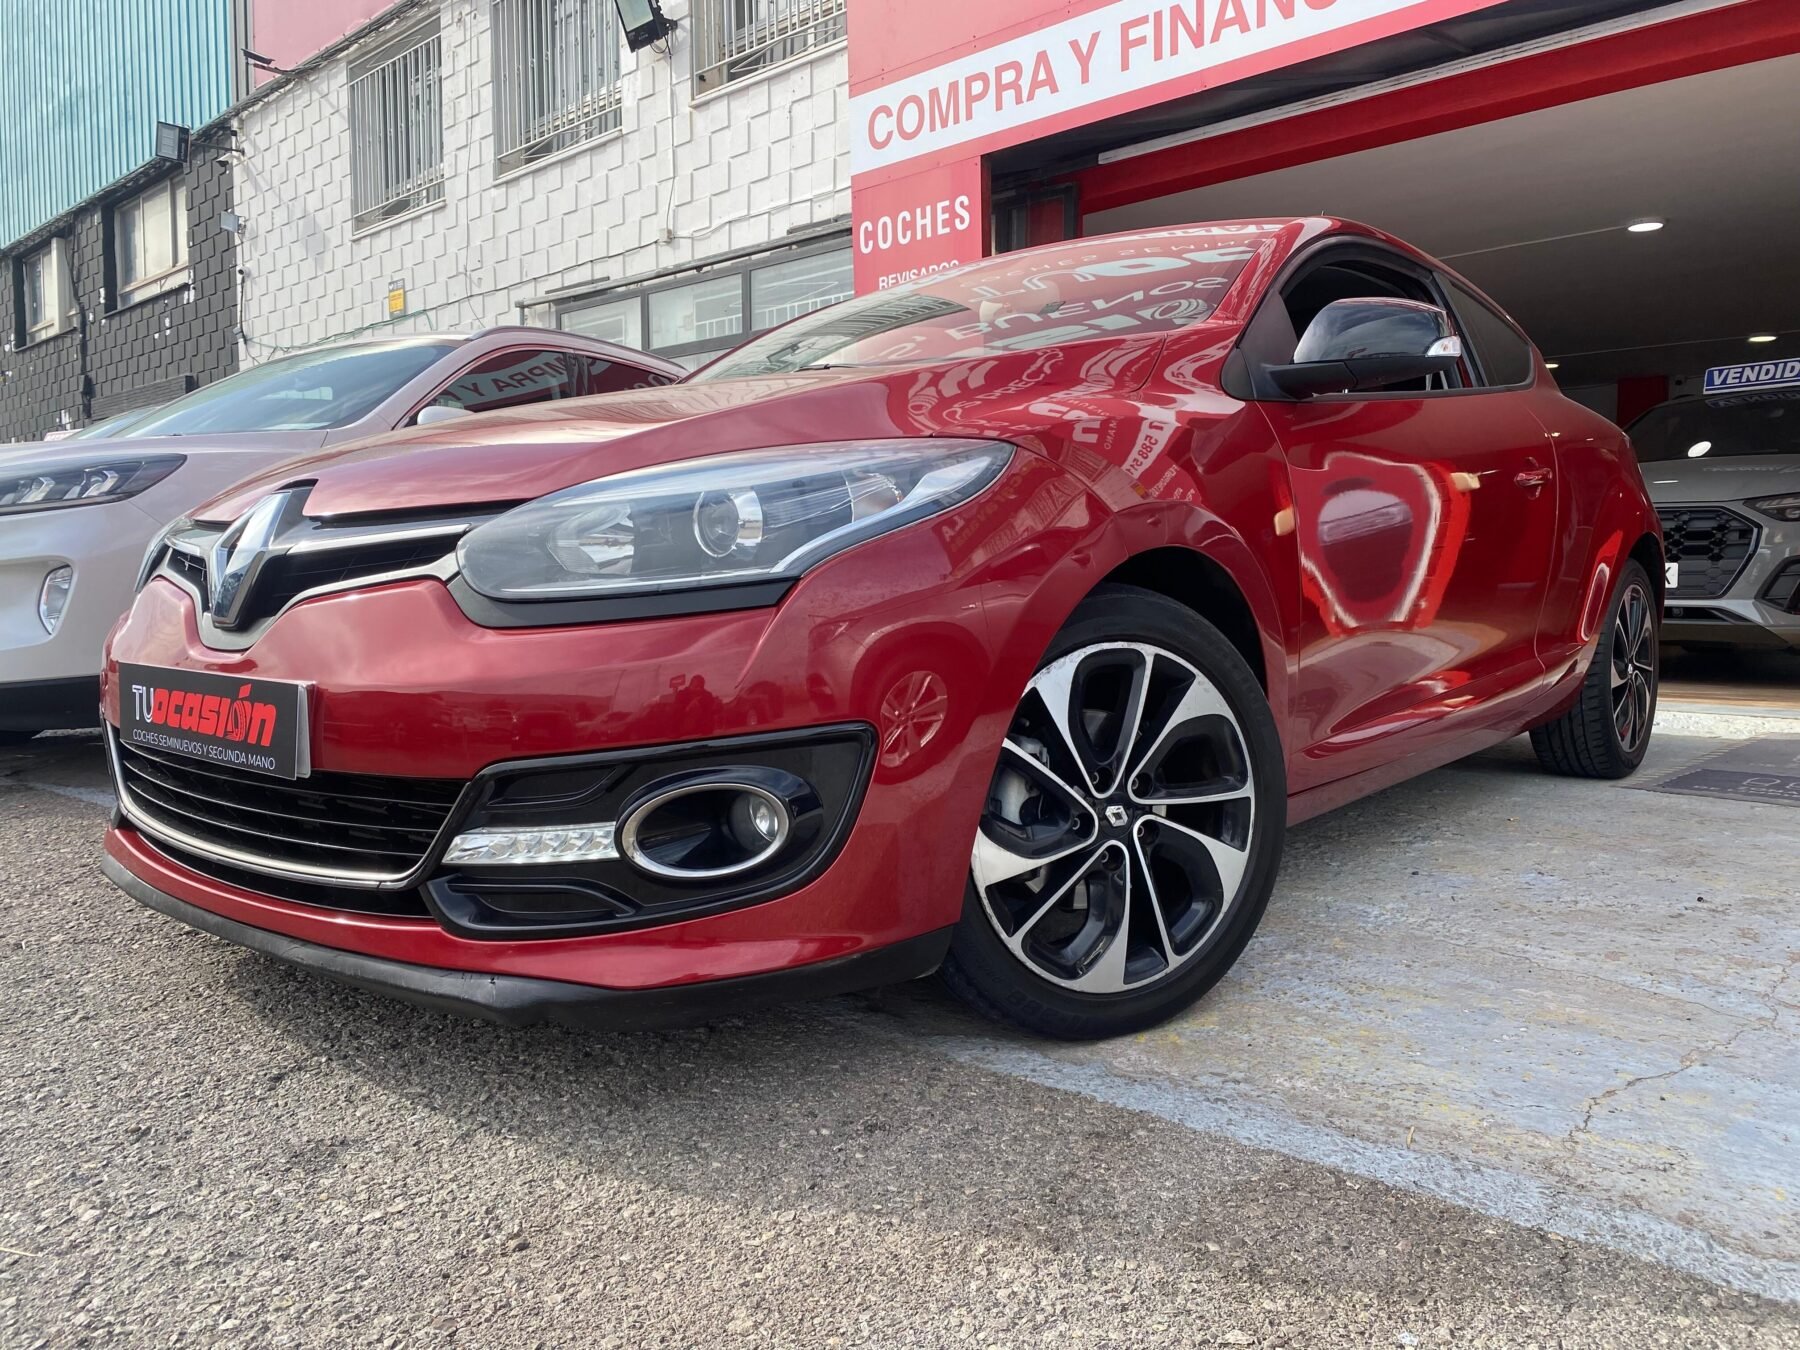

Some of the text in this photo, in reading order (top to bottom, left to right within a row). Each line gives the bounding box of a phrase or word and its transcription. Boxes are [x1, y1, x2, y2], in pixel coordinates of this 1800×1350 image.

[867, 50, 1059, 150] COMPRA
[1069, 31, 1102, 85] Y
[859, 195, 970, 254] COCHES
[132, 728, 276, 770] COCHES SEMINUEVOS Y SEGUNDA MANO
